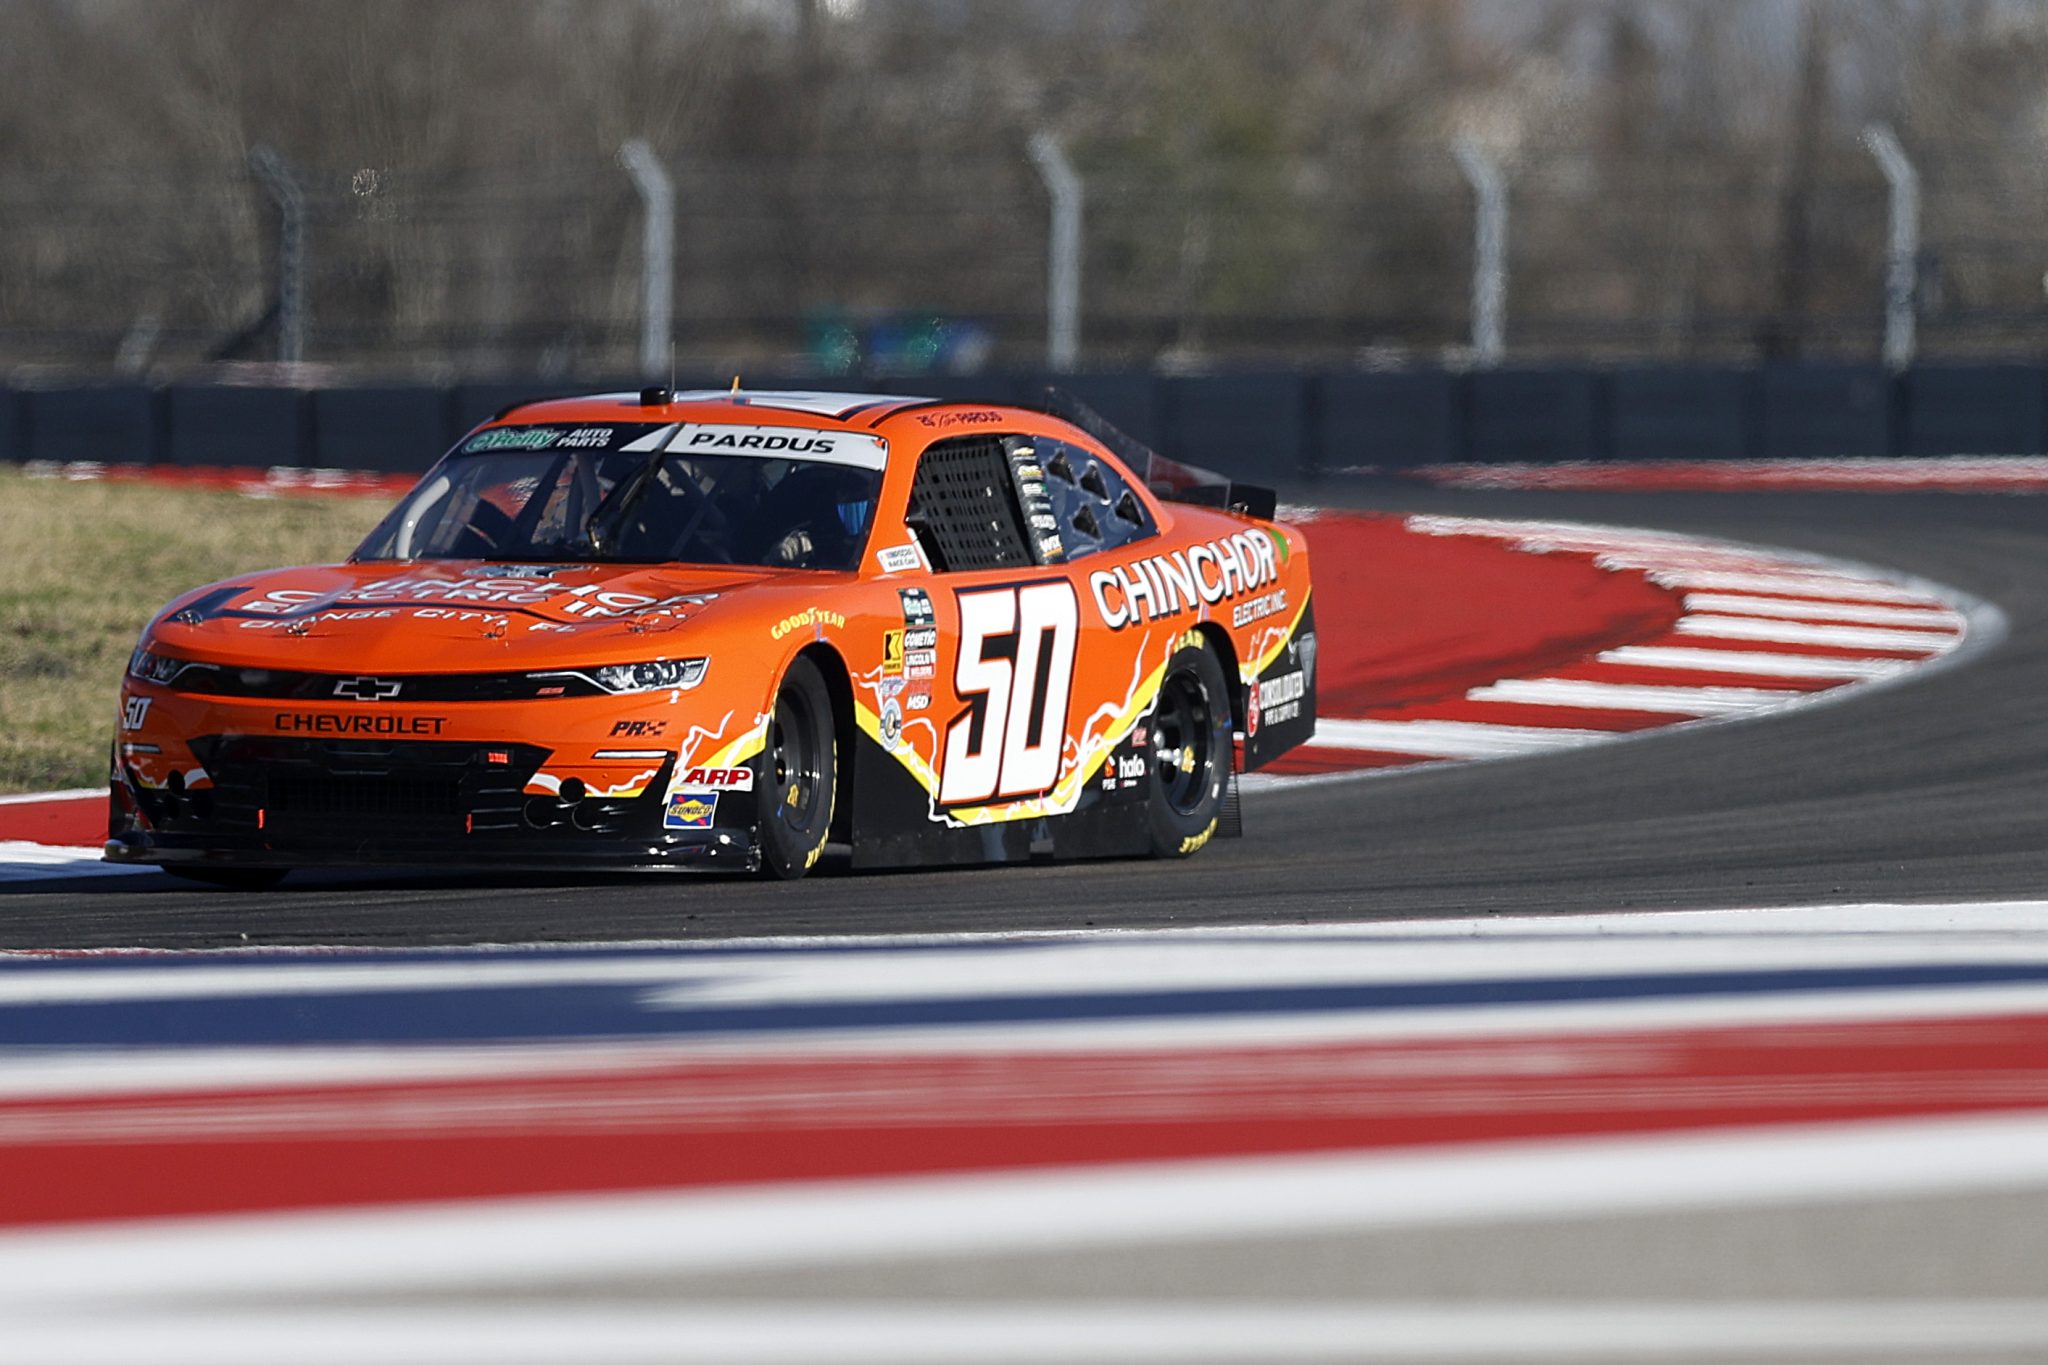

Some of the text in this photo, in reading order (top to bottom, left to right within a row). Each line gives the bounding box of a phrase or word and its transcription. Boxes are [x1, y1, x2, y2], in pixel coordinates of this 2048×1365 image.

[556, 437, 611, 448] PARTS
[568, 428, 613, 438] AUTO
[689, 432, 835, 454] PARDUS
[1090, 528, 1277, 632] CHINCHOR
[770, 606, 845, 640] GOODYEAR
[1233, 595, 1272, 629] ELECTRIC
[906, 694, 931, 709] MSD
[940, 581, 1078, 804] 50
[122, 697, 152, 729] 50
[273, 712, 447, 735] CHEVROLET
[683, 769, 751, 785] ARP
[1118, 753, 1145, 779] halo
[669, 805, 713, 816] SUNOCO
